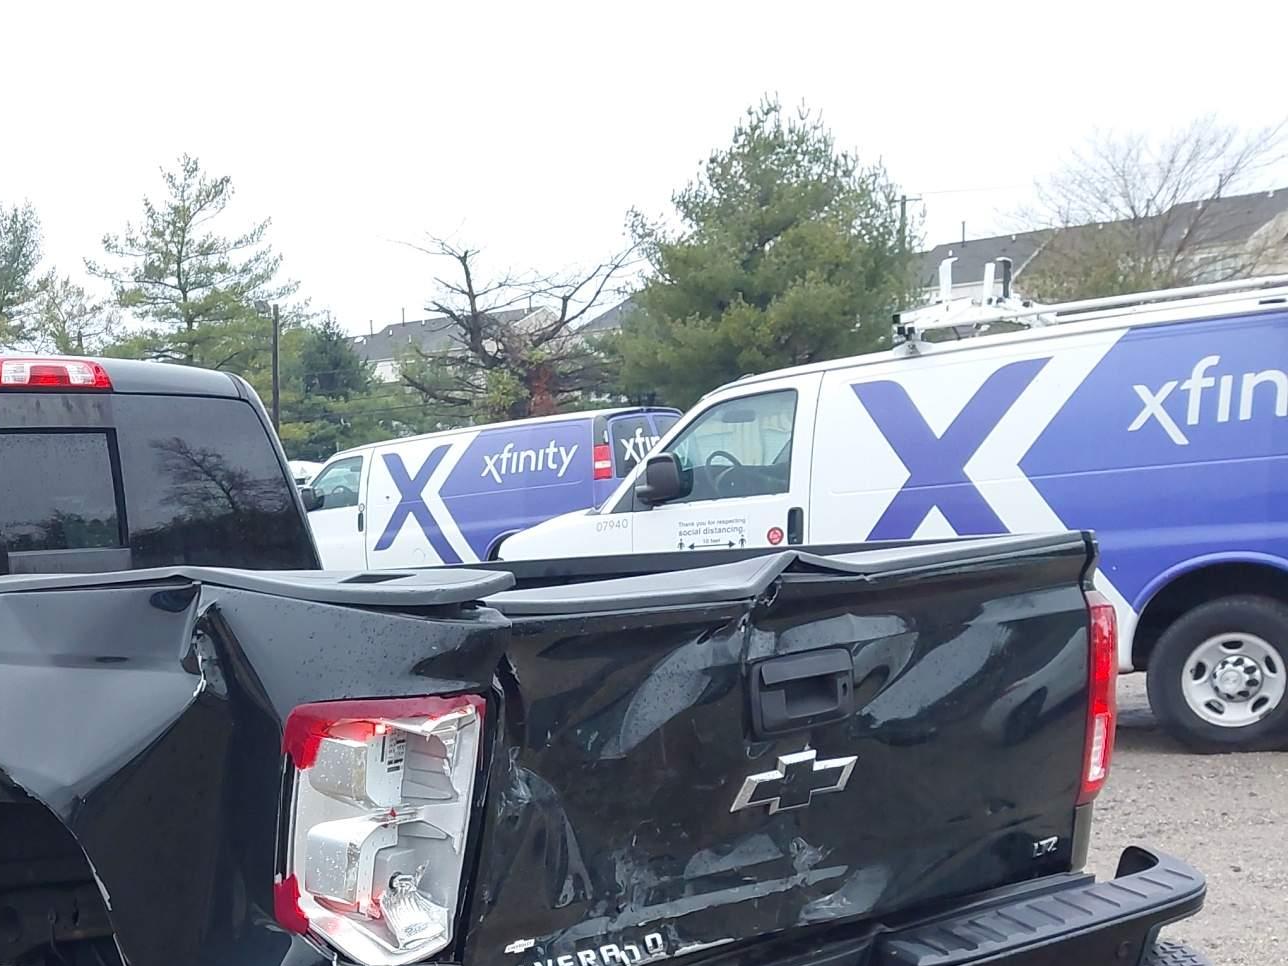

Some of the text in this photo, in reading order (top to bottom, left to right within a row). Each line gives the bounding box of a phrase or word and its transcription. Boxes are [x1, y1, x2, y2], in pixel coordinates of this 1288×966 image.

[481, 440, 578, 483] xfinity
[596, 518, 629, 532] 07940
[678, 526, 746, 536] social distancing.
[1033, 836, 1058, 858] LTZ
